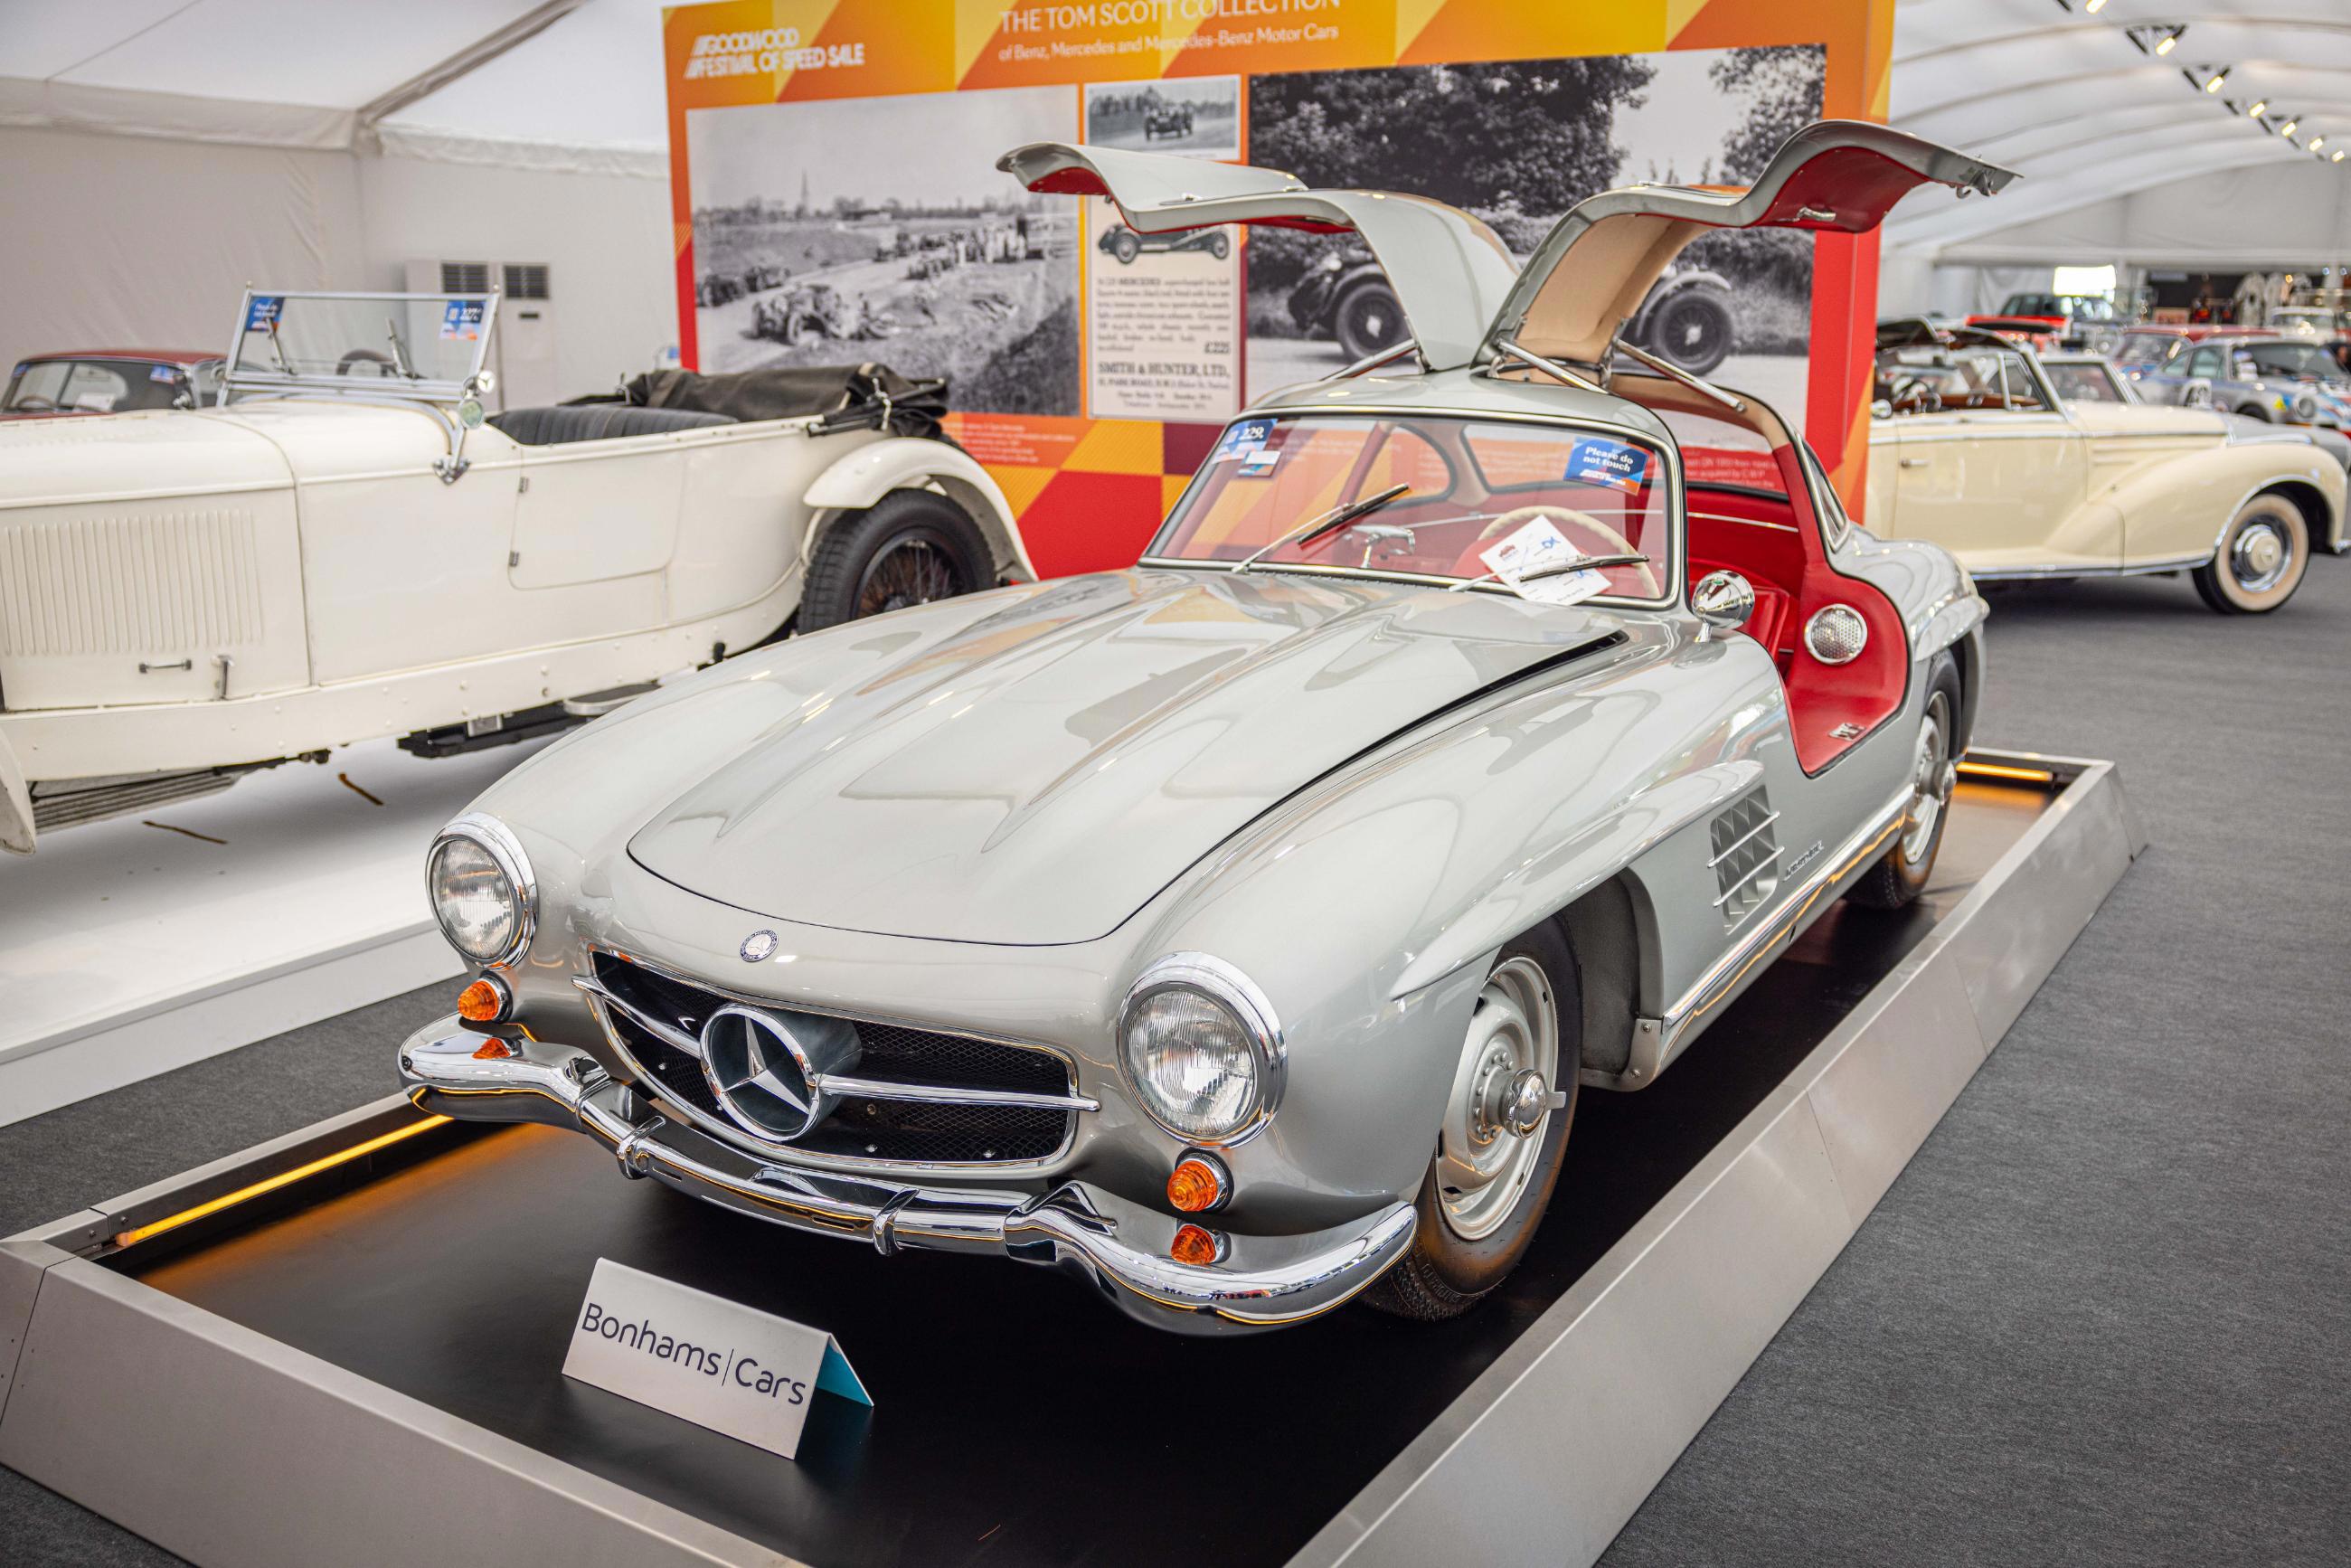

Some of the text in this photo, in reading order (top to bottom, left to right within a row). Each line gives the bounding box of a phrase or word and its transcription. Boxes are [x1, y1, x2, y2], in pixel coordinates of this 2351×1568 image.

[998, 9, 1042, 33] THE
[1045, 4, 1096, 30] TOM
[1098, 0, 1175, 26] SCOTT
[998, 22, 1340, 61] of Benz, Mercedes and Mercedes-Benz Motor Cars
[758, 49, 780, 72] OF
[781, 47, 826, 70] SPEED
[827, 43, 865, 67] SALE
[1098, 362, 1135, 374] SMITH
[1138, 364, 1146, 374] &
[1582, 456, 1631, 472] not touch
[1585, 446, 1634, 465] Please do
